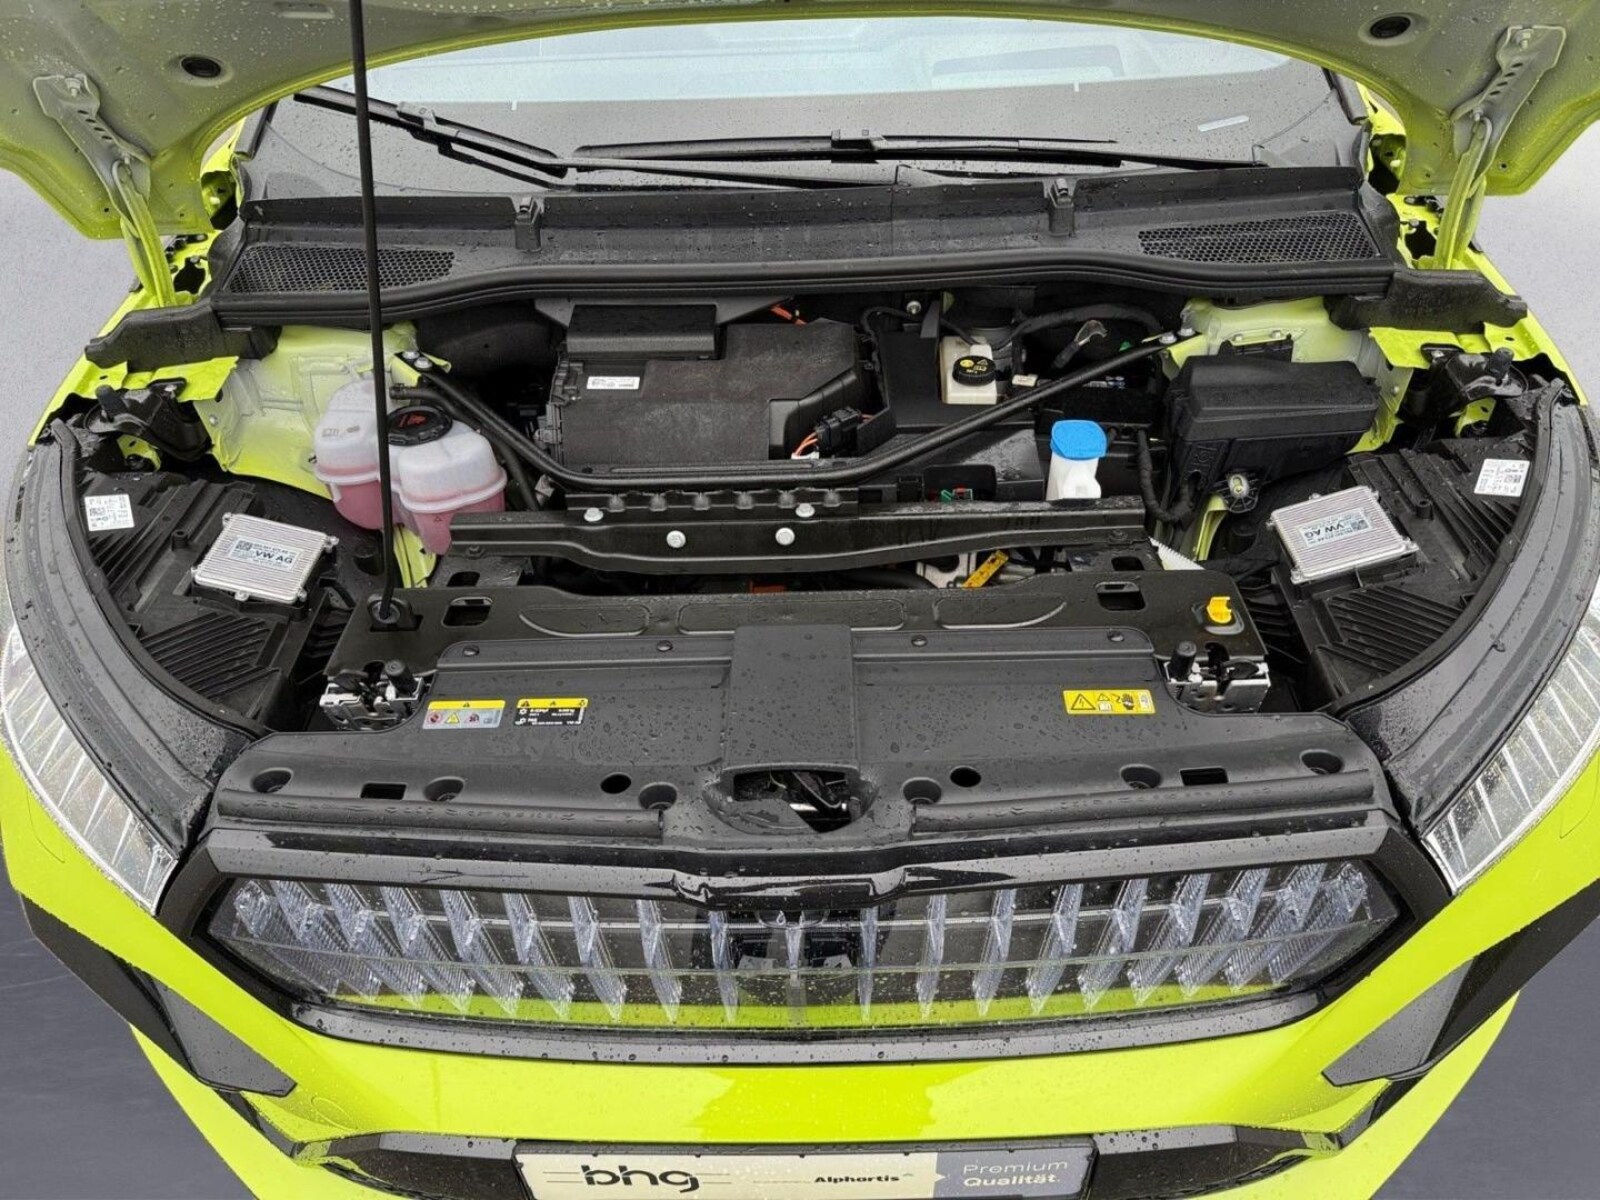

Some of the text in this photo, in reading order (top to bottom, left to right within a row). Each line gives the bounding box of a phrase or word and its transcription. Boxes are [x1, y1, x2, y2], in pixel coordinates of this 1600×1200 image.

[1304, 529, 1321, 539] AG
[1325, 523, 1344, 533] VW
[255, 550, 275, 560] VW
[275, 555, 293, 564] AG
[962, 1161, 1068, 1175] Premium
[581, 1165, 700, 1193] bhg
